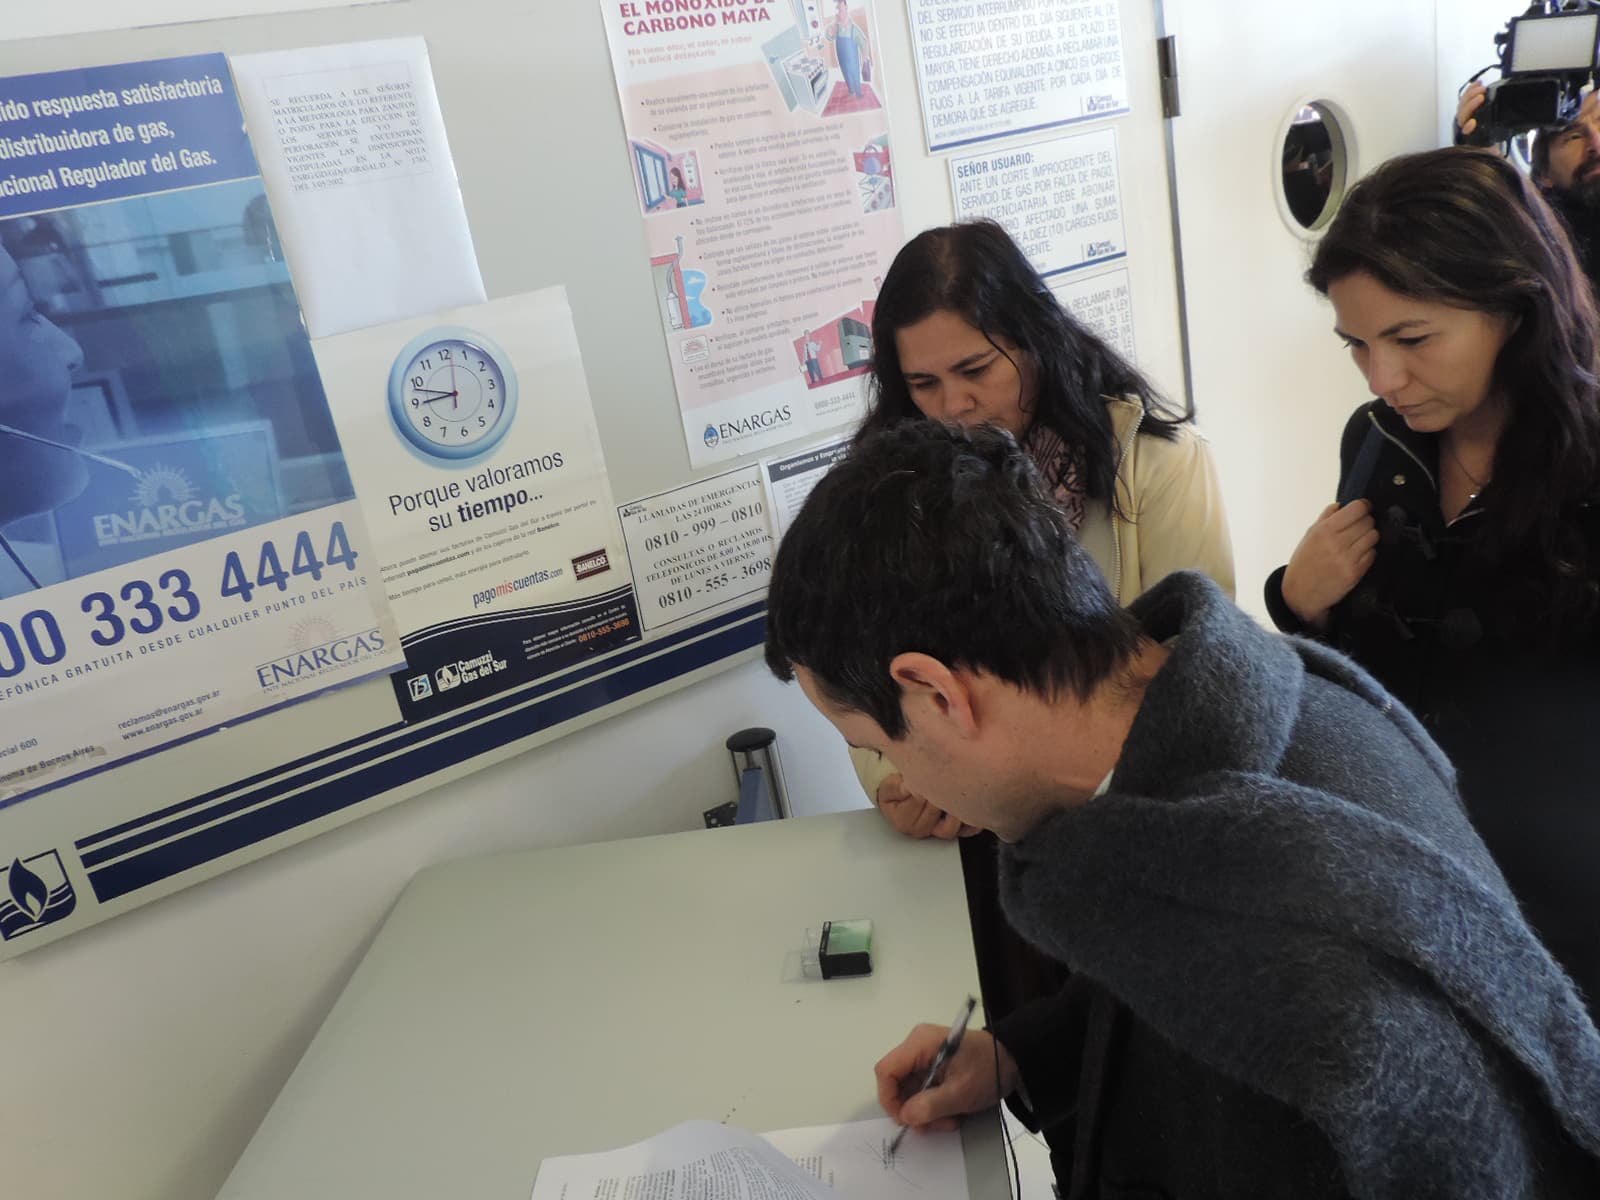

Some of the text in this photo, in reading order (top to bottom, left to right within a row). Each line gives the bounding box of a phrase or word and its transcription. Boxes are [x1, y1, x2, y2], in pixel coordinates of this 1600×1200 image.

[619, 3, 641, 18] EL
[623, 7, 771, 36] CARBONO MATA
[917, 10, 934, 24] DEL
[936, 6, 974, 22] SERVICIO
[959, 55, 980, 71] TIENE
[0, 75, 223, 122] ido respuesta satisfactoria
[968, 90, 979, 104] LA
[932, 109, 969, 128] DEMORA
[0, 120, 175, 160] distribuidora de gas,
[60, 158, 147, 188] Regulador
[152, 151, 178, 173] del
[180, 148, 217, 168] Gas.
[957, 152, 1034, 179] SEÑOR USUARIO:
[959, 151, 1113, 194] ANTE UN CORTE IMPROCEDENTE DEL
[961, 191, 999, 211] SERVICIO
[1001, 187, 1014, 201] DE
[1015, 183, 1033, 198] GAS
[1034, 178, 1052, 194] POR
[1053, 172, 1077, 189] FALTA
[1078, 170, 1090, 184] DE
[981, 179, 1116, 220] LICENCIATARIA DEBE ABONAR
[1025, 206, 1066, 225] AFECTADO
[1072, 201, 1089, 215] UNA
[1094, 195, 1117, 210] SUMA
[1029, 226, 1048, 242] DIEZ
[1049, 220, 1065, 239] (10)
[1065, 213, 1097, 233] CARGOS
[420, 359, 432, 371] 11
[438, 349, 451, 361] 12
[462, 350, 468, 360] 1
[478, 361, 486, 372] 2
[411, 376, 424, 389] 10
[488, 379, 495, 390] 3
[411, 398, 420, 409] 9
[488, 399, 495, 409] 4
[422, 416, 432, 427] 8
[440, 426, 447, 438] 7
[461, 426, 469, 437] 6
[479, 416, 486, 428] 5
[719, 405, 791, 439] ENARGAS
[388, 451, 565, 516] Porque valoramos
[428, 489, 543, 532] su tiempo...
[638, 503, 687, 523] LLAMADAS
[688, 497, 699, 507] DE
[700, 479, 761, 503] EMERGENCIAS
[675, 512, 692, 523] LAS
[703, 499, 733, 514] HORAS
[93, 494, 245, 539] ENARGAS
[645, 502, 762, 552] 0810 999 0810
[654, 527, 763, 570] CONSULTAS O RECLAMOS
[707, 554, 717, 563] DE
[473, 556, 606, 608] pagomiscuentas.com BANELCO
[670, 550, 756, 586] DE LUNES VIERNES
[658, 557, 772, 609] 0810 555 3698
[0, 609, 66, 678] 00
[81, 569, 200, 646] 333
[221, 521, 358, 602] 4444
[65, 650, 134, 679] GRATUITA
[139, 634, 183, 655] DESDE
[188, 609, 260, 640] CUALQUIER
[266, 595, 305, 614] PUNTO
[312, 587, 334, 600] DEL
[340, 576, 367, 592] PAÍS
[256, 629, 385, 688] ENARGAS
[458, 650, 493, 672] Camuzzi
[461, 659, 507, 683] Gas del Sur
[118, 690, 220, 729] reclamos@enargas.gov.ar
[122, 708, 203, 741] www.enargas.gov.ar
[20, 738, 38, 750] 600
[26, 765, 38, 773] de
[39, 754, 71, 768] Buenos
[72, 745, 95, 757] Aires
